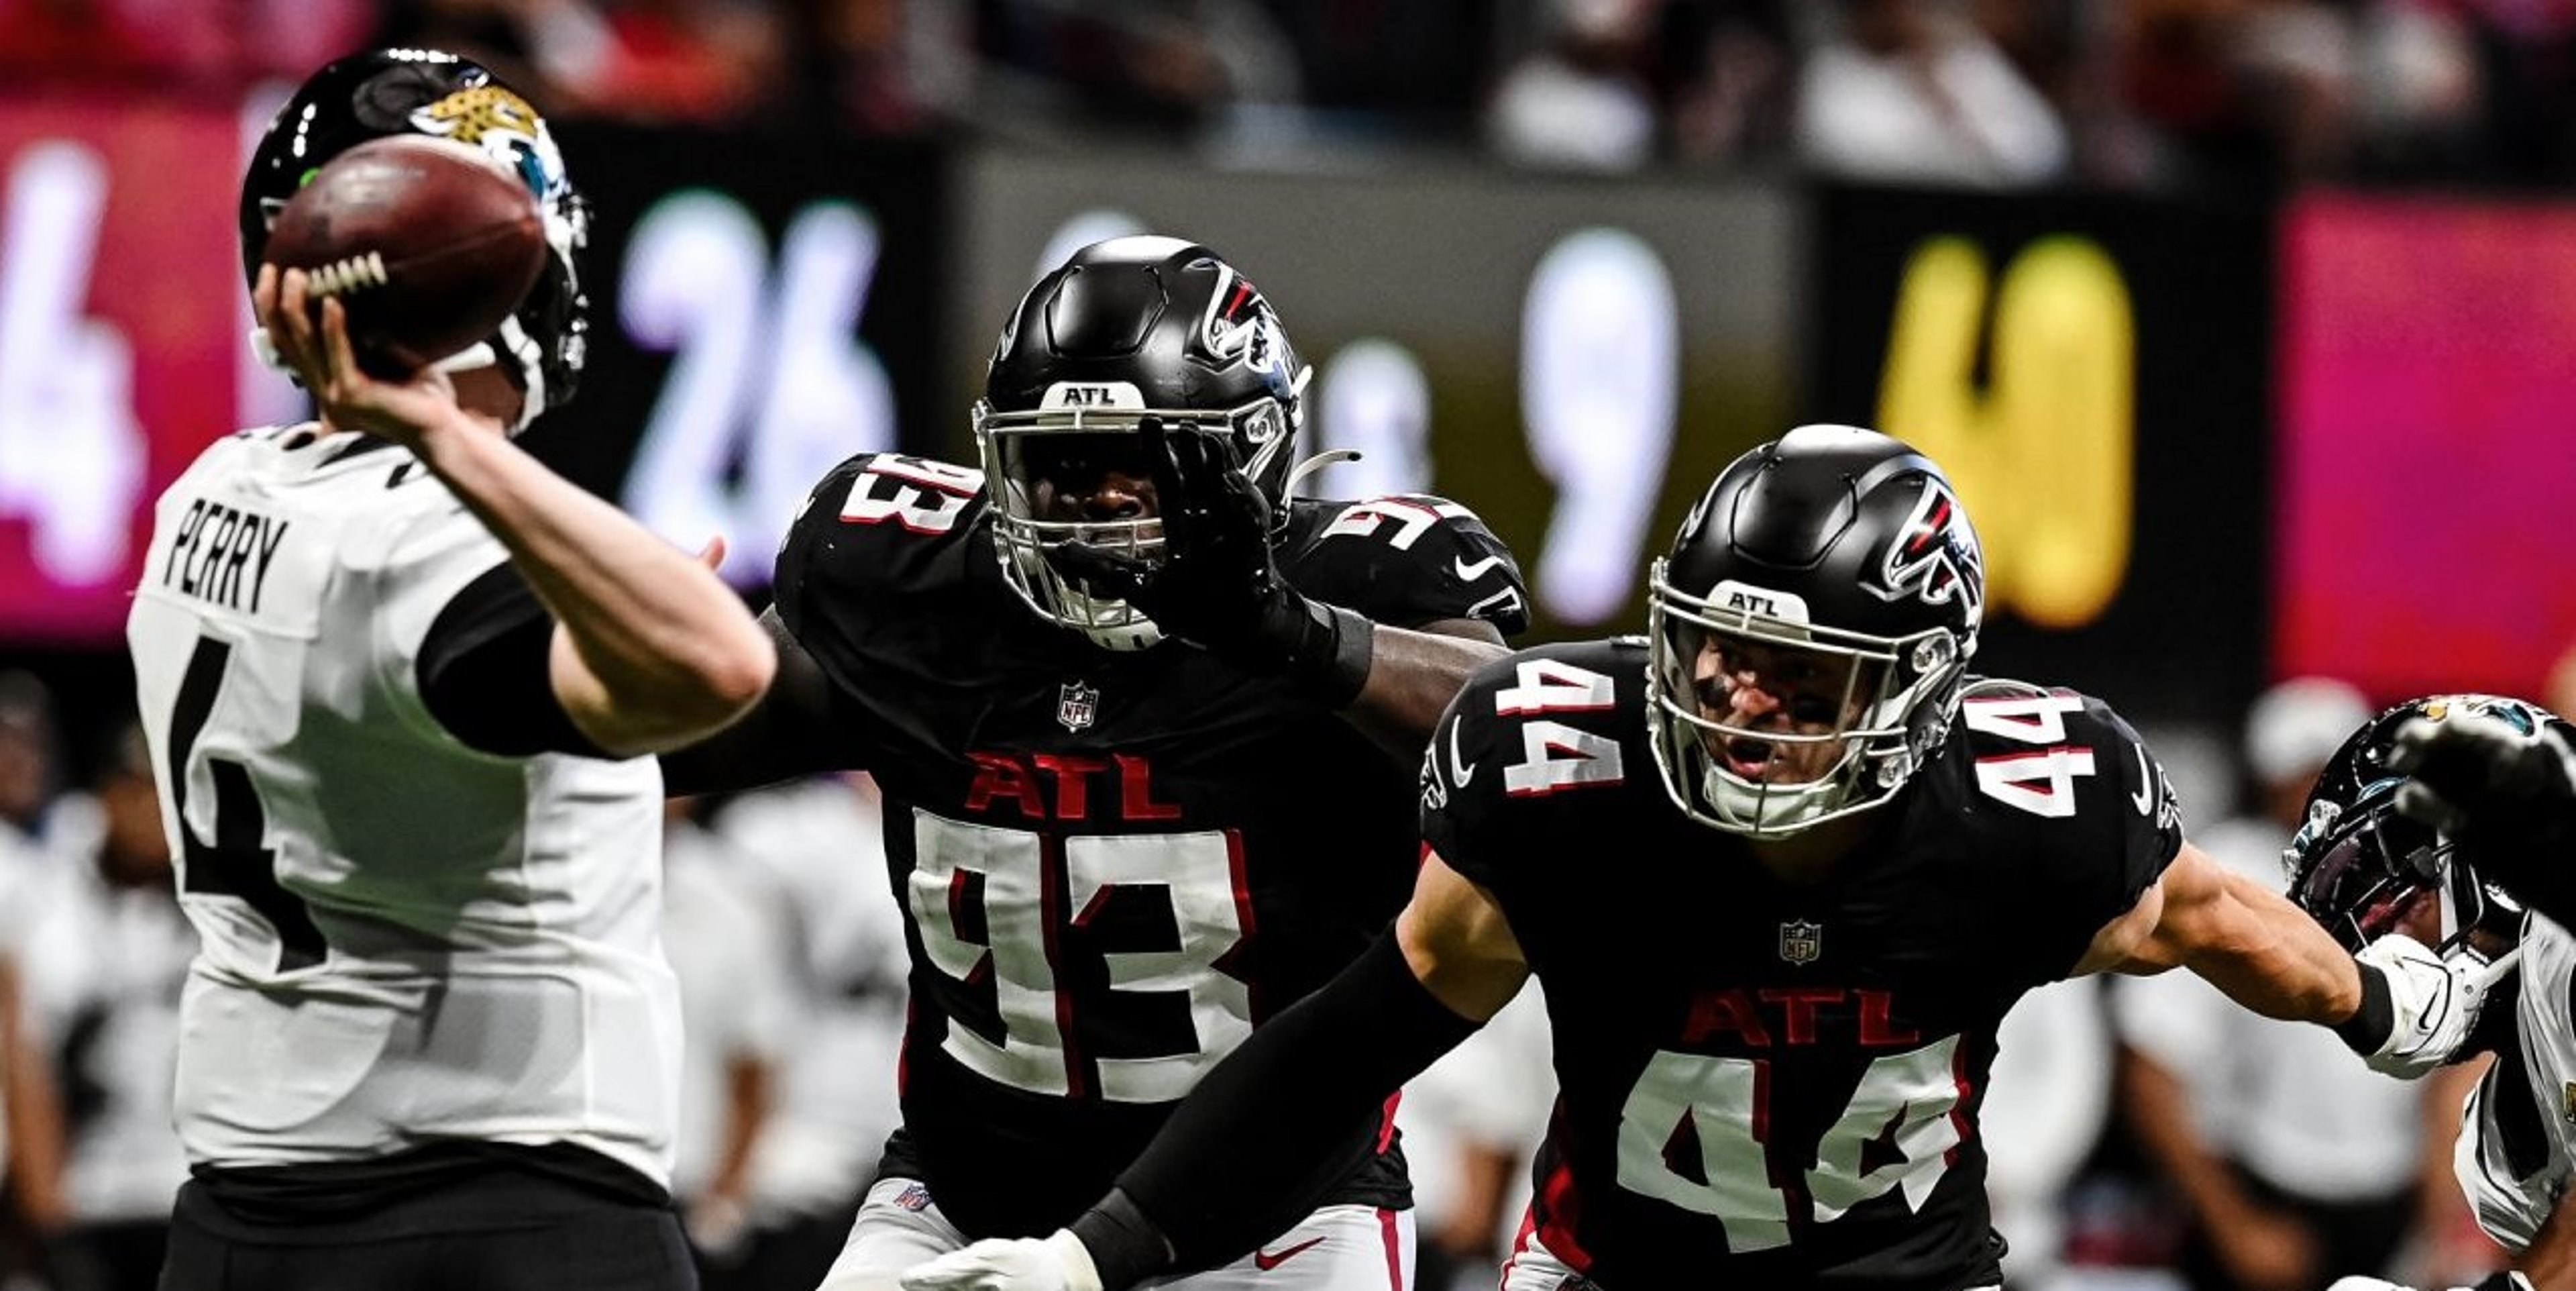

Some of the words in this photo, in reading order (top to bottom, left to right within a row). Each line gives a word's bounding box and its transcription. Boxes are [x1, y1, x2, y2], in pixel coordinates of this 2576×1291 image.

[1064, 388, 1115, 405] ATL
[163, 499, 289, 615] PERRY
[1729, 592, 1779, 617] ATL
[965, 751, 1182, 820] ATL
[1495, 658, 1625, 797] 44
[1962, 690, 2097, 817] 44
[168, 636, 329, 973] 4
[908, 807, 1257, 1104] 93
[1681, 988, 1919, 1046] ATL
[1617, 1033, 1971, 1253] 44
